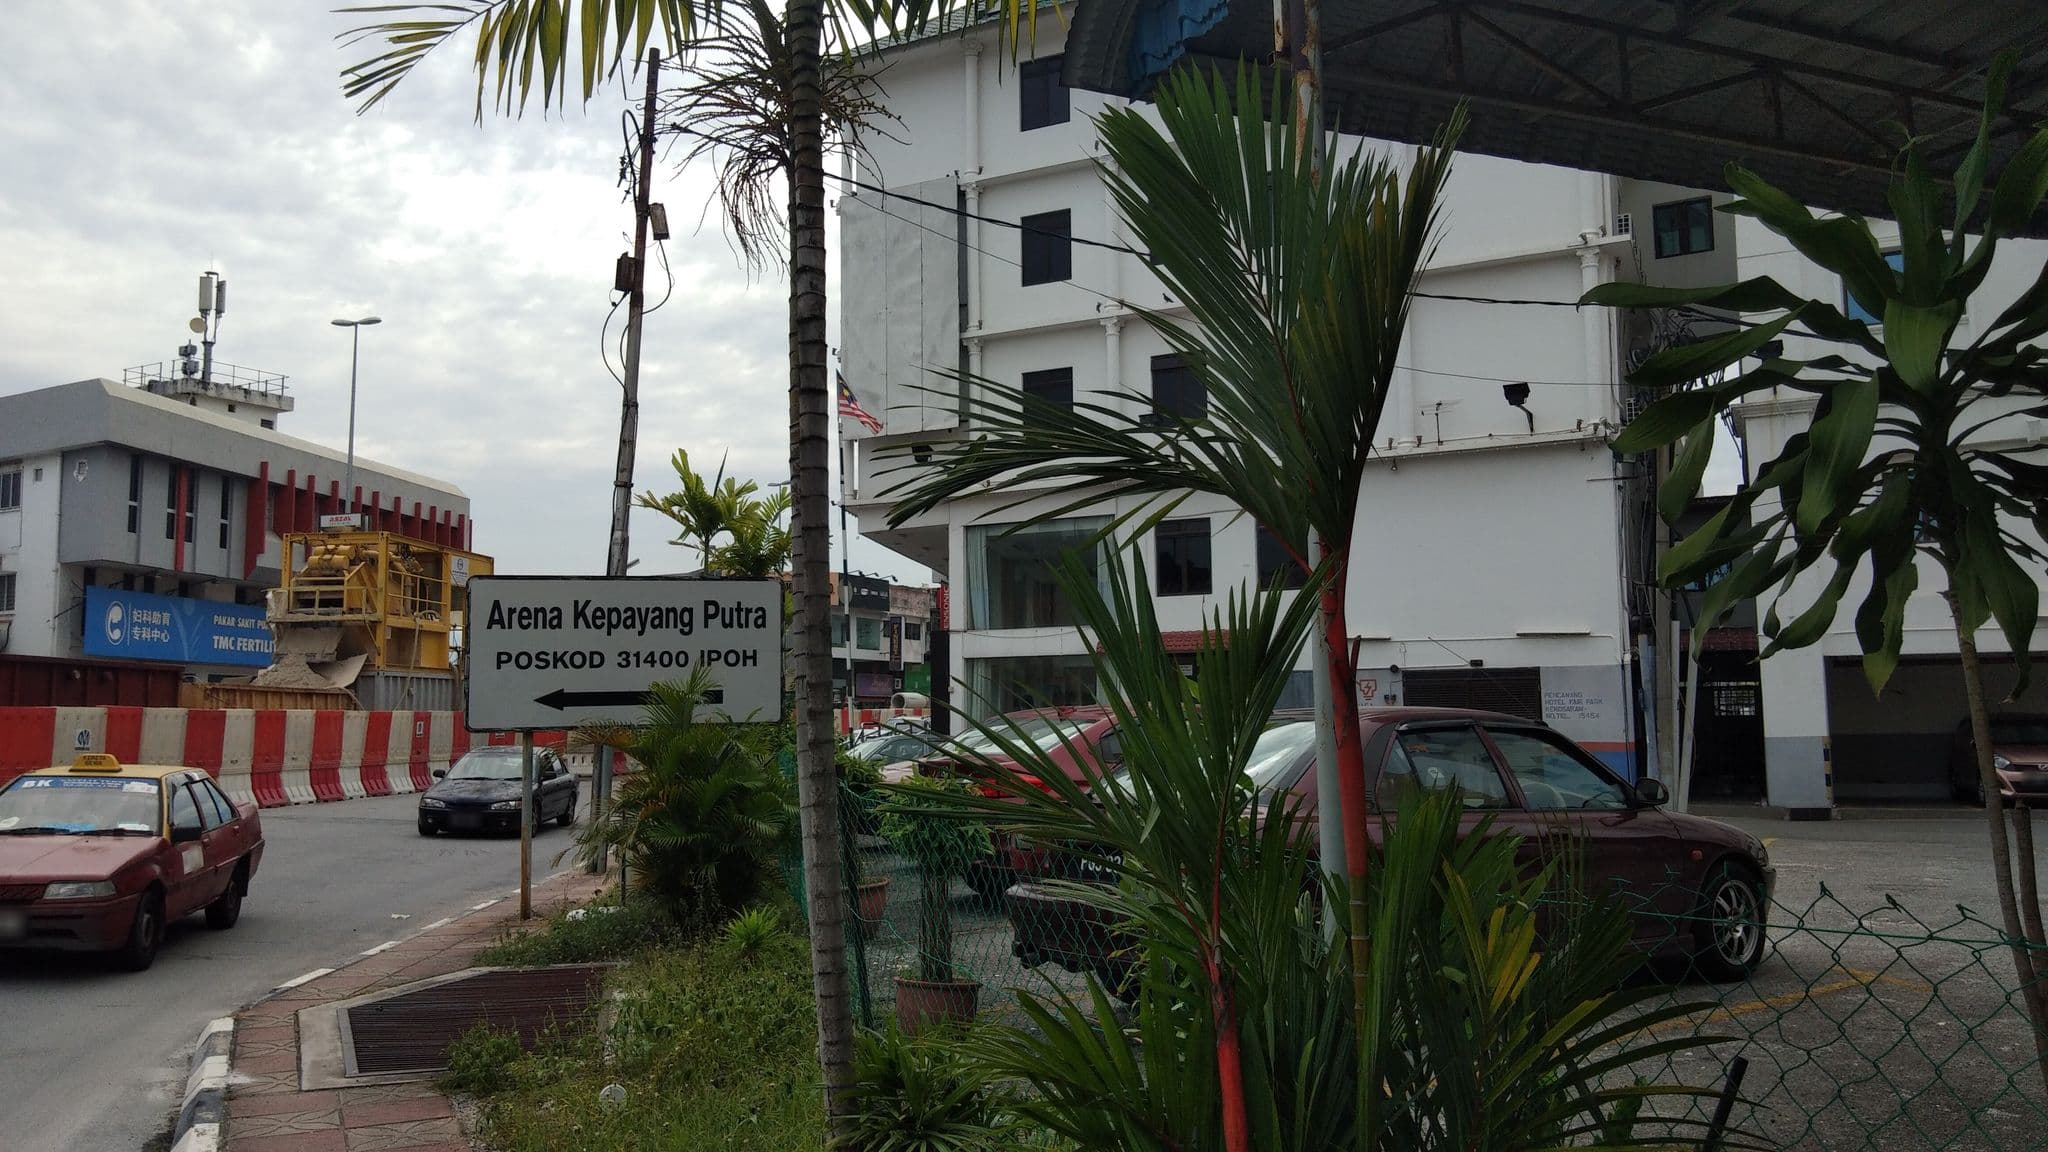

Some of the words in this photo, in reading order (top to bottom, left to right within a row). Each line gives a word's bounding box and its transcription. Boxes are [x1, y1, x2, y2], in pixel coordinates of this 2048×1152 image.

[132, 609, 171, 626] 妇科助育
[213, 615, 235, 626] PAKAR
[237, 617, 256, 629] SAKIT
[257, 620, 269, 631] PU
[486, 599, 563, 630] Arena
[573, 599, 694, 636] Kepayang
[703, 599, 766, 630] Putra
[131, 626, 169, 642] 专科中心
[213, 635, 235, 650] TMC
[495, 650, 606, 670] POSKOD
[616, 650, 690, 669] 31400
[700, 650, 758, 668] IPOH
[22, 779, 54, 789] BK
